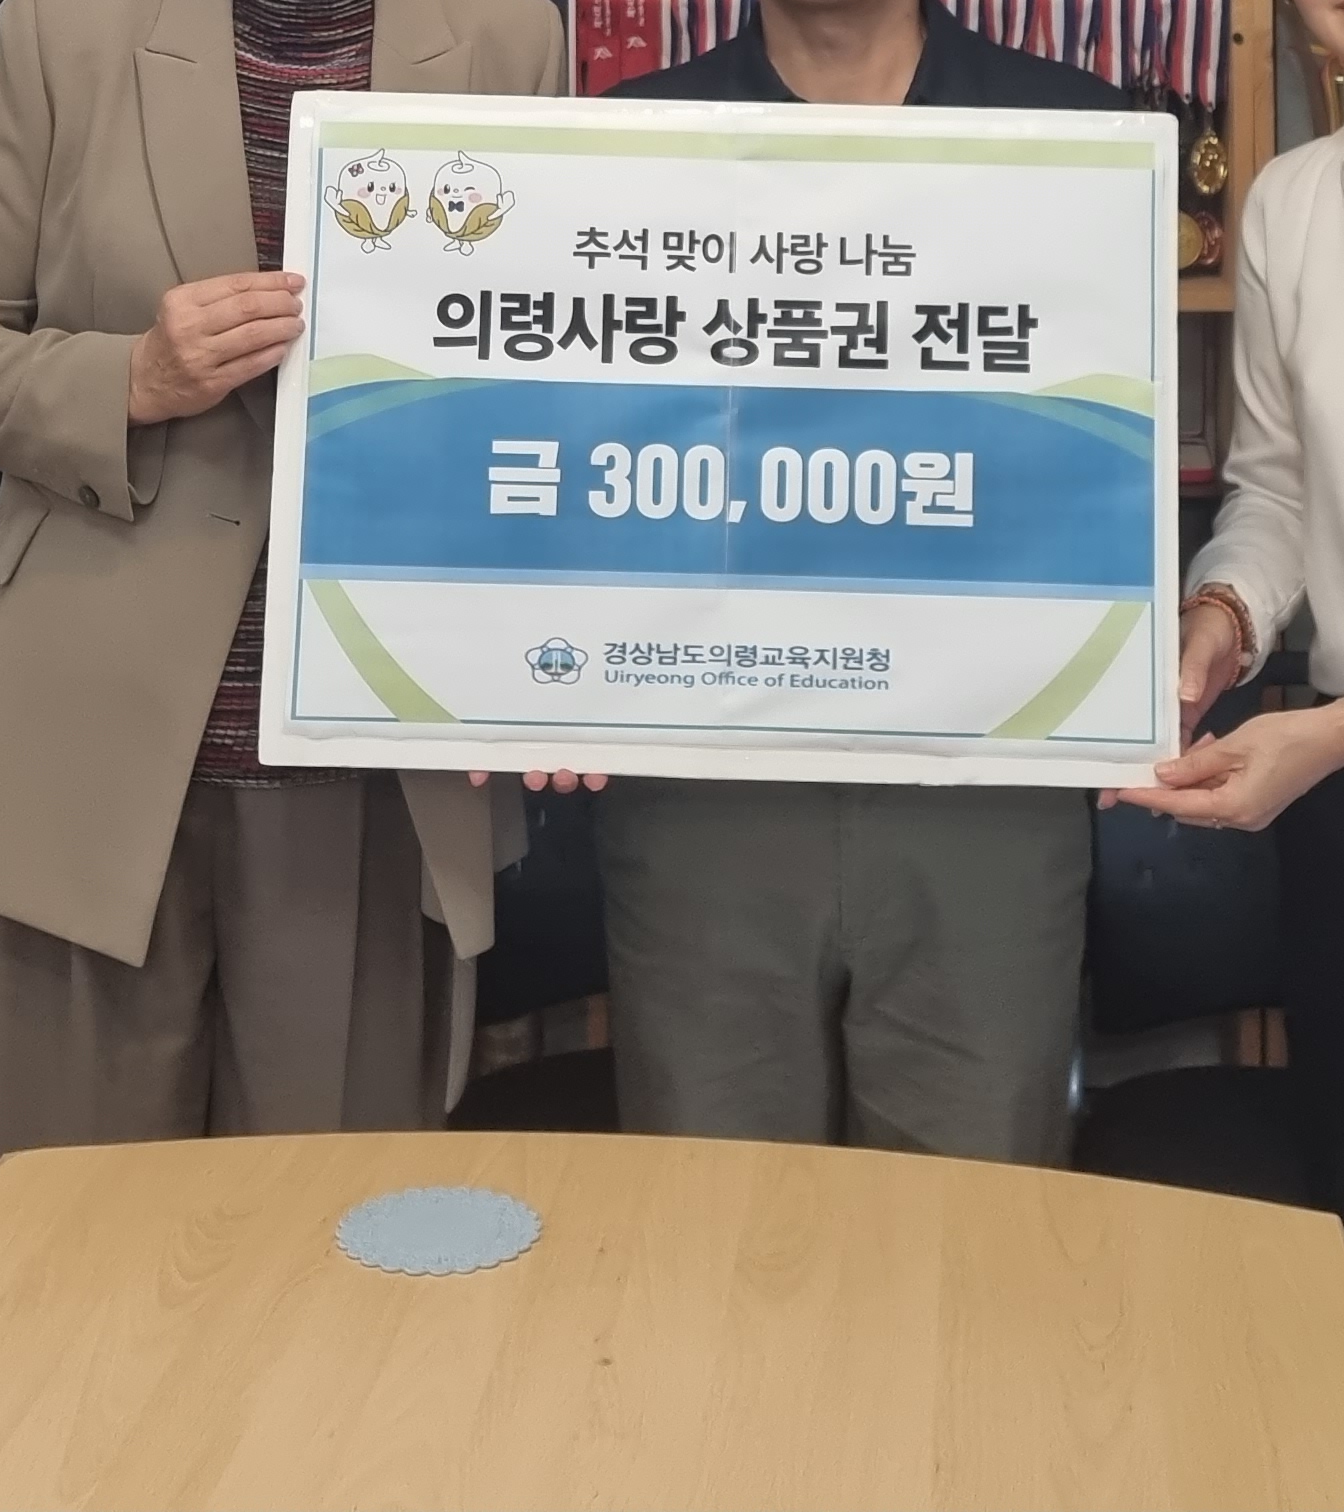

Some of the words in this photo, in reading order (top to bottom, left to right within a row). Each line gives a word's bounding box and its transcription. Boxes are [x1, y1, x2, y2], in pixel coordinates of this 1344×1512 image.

[572, 226, 651, 273] 추석
[661, 229, 737, 274] 맞이
[749, 230, 828, 276] 사랑
[838, 232, 917, 277] 나눔
[432, 290, 686, 365] 의령사랑
[702, 296, 892, 370] 상품권
[910, 302, 1039, 373] 전달
[487, 439, 561, 518] 금
[588, 441, 975, 528] 300,000원
[603, 641, 891, 672] 경상남도의령교육지원청
[604, 669, 695, 688] Uiryeong
[701, 670, 759, 687] Office
[764, 673, 786, 687] of
[789, 674, 890, 691] Education
